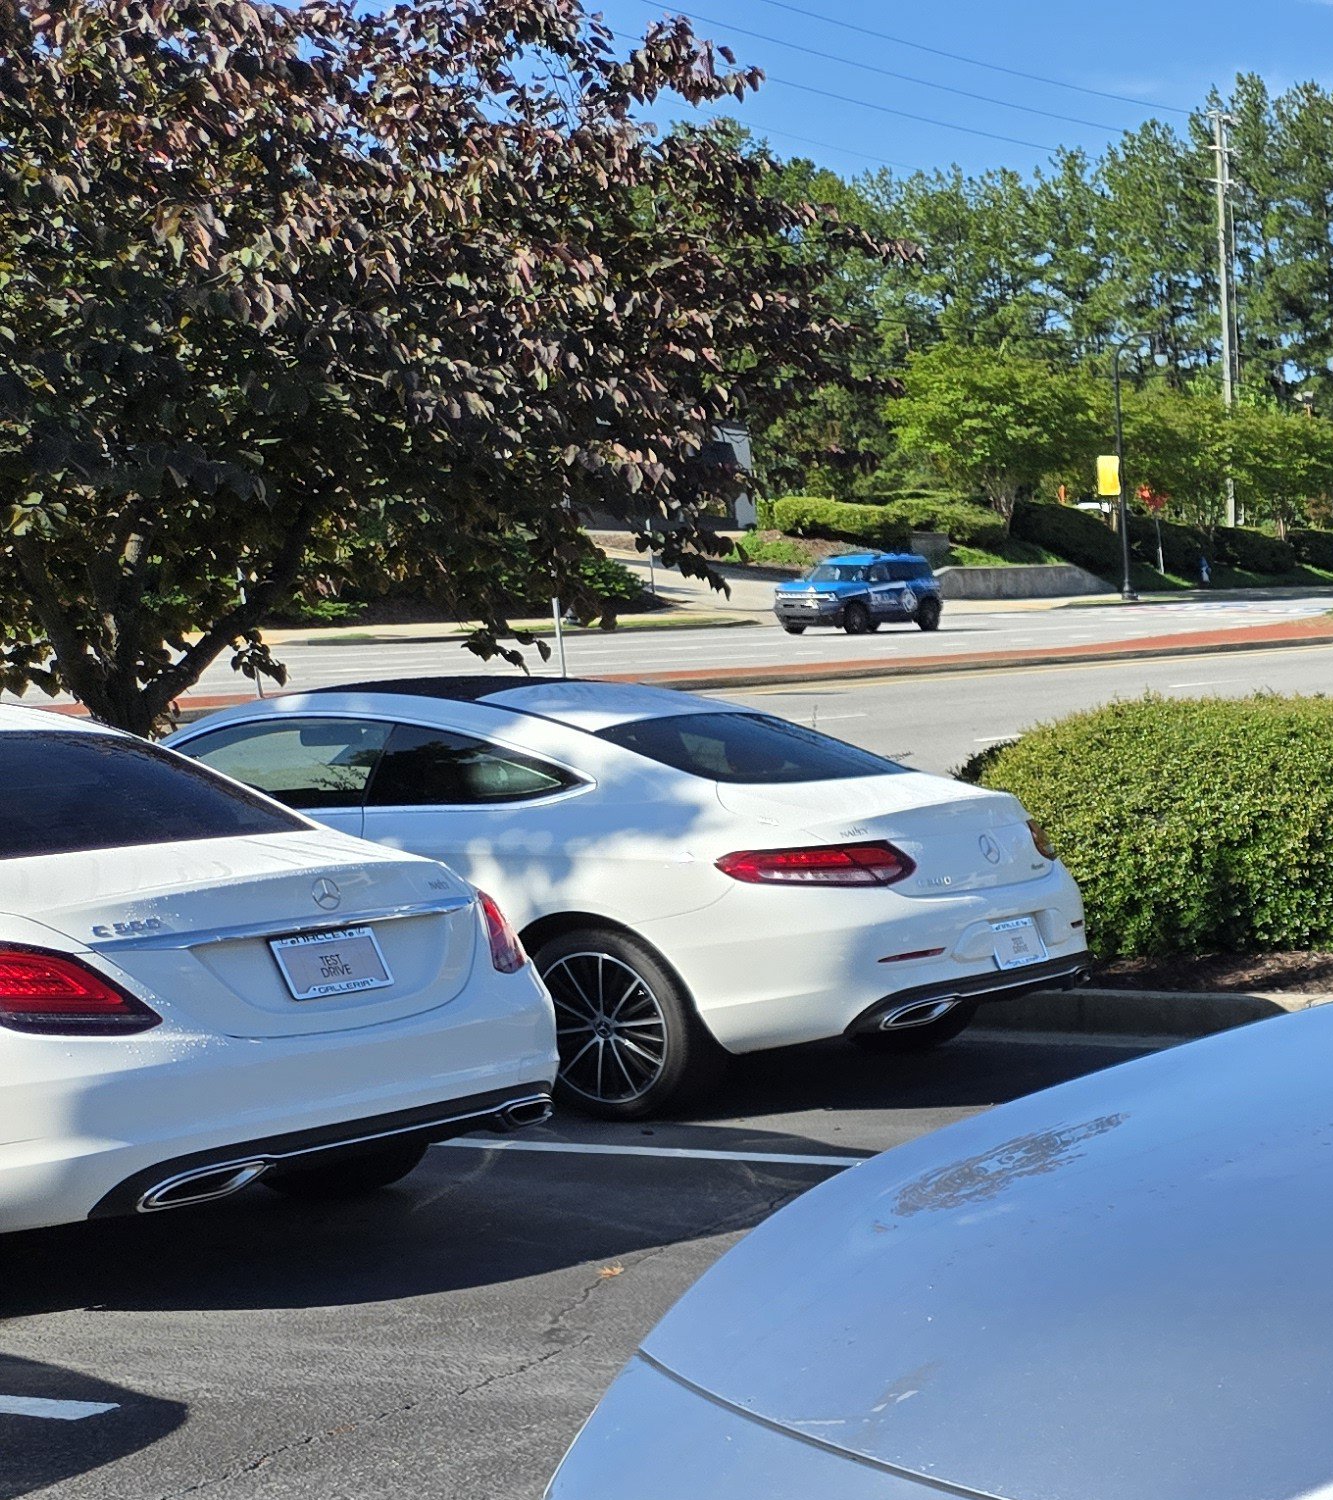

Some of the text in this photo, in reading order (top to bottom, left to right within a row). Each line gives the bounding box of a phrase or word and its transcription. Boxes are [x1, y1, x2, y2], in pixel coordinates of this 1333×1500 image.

[319, 953, 343, 967] TEST
[320, 963, 353, 979] DRIVE
[317, 980, 370, 994] GALLERIA
